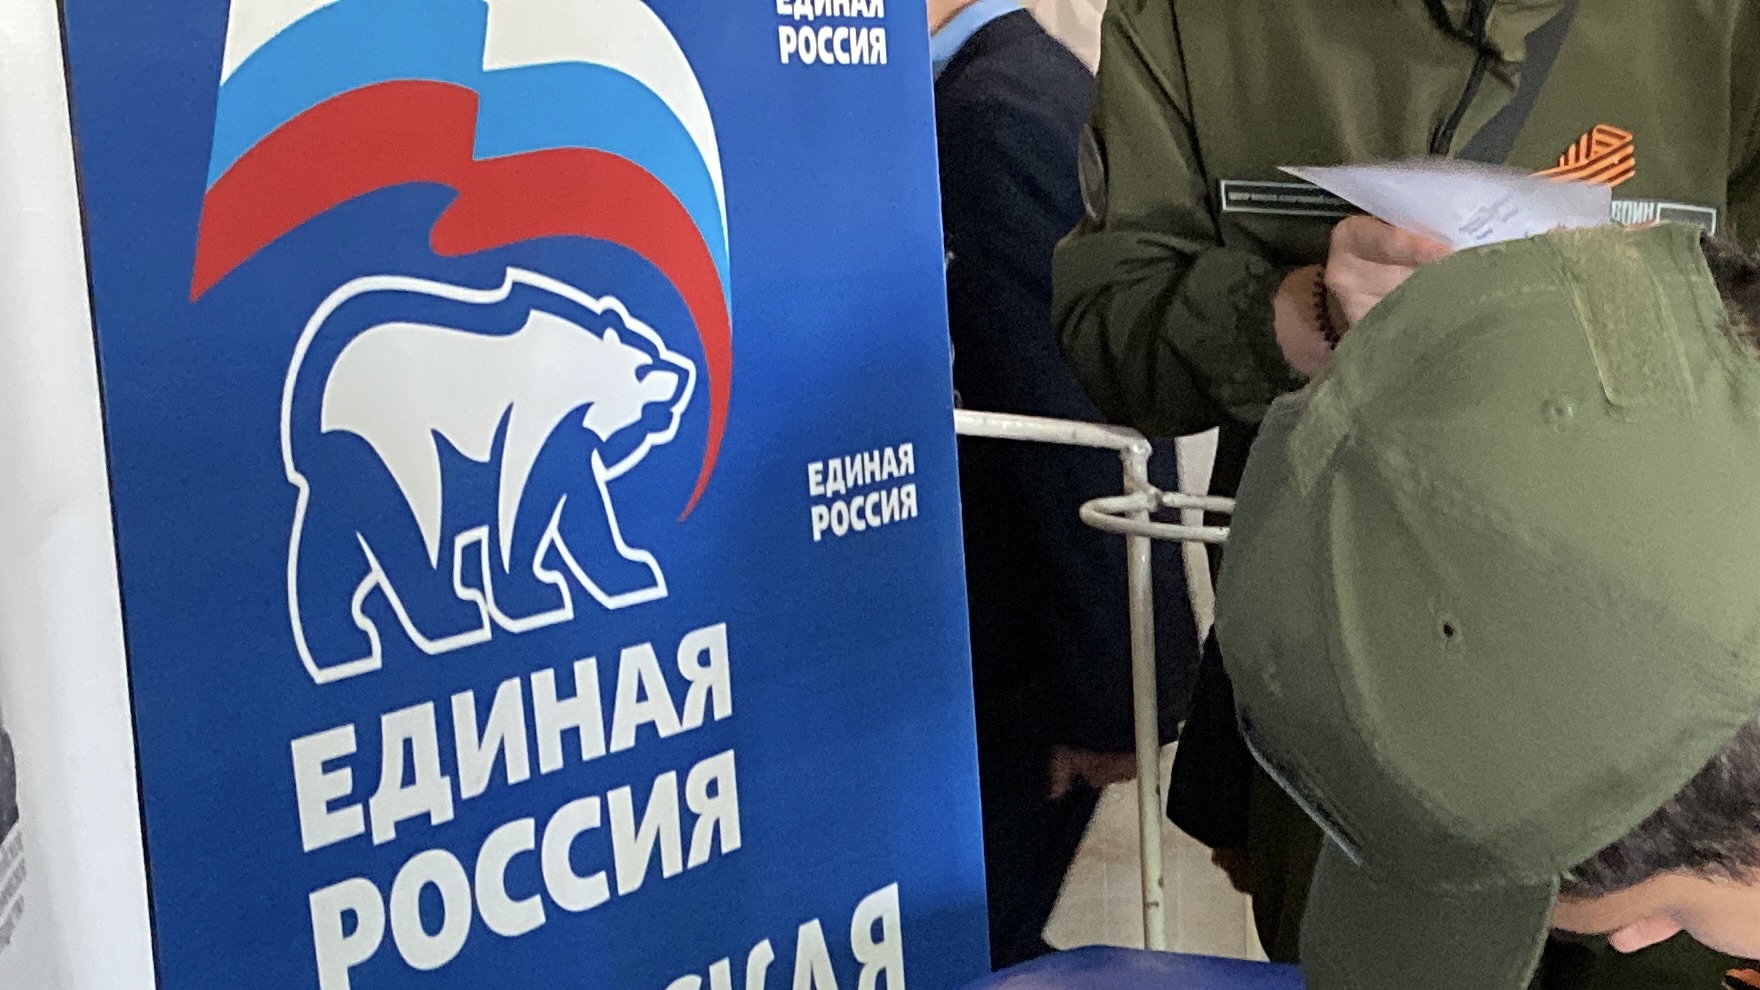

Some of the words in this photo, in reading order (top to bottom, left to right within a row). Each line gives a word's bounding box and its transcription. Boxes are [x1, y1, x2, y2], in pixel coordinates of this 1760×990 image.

[778, 25, 887, 64] РОССИЯ
[808, 442, 915, 498] ЕДИНАЯ
[811, 483, 917, 542] РОССИЯ
[291, 623, 733, 852] ЕДИНАЯ
